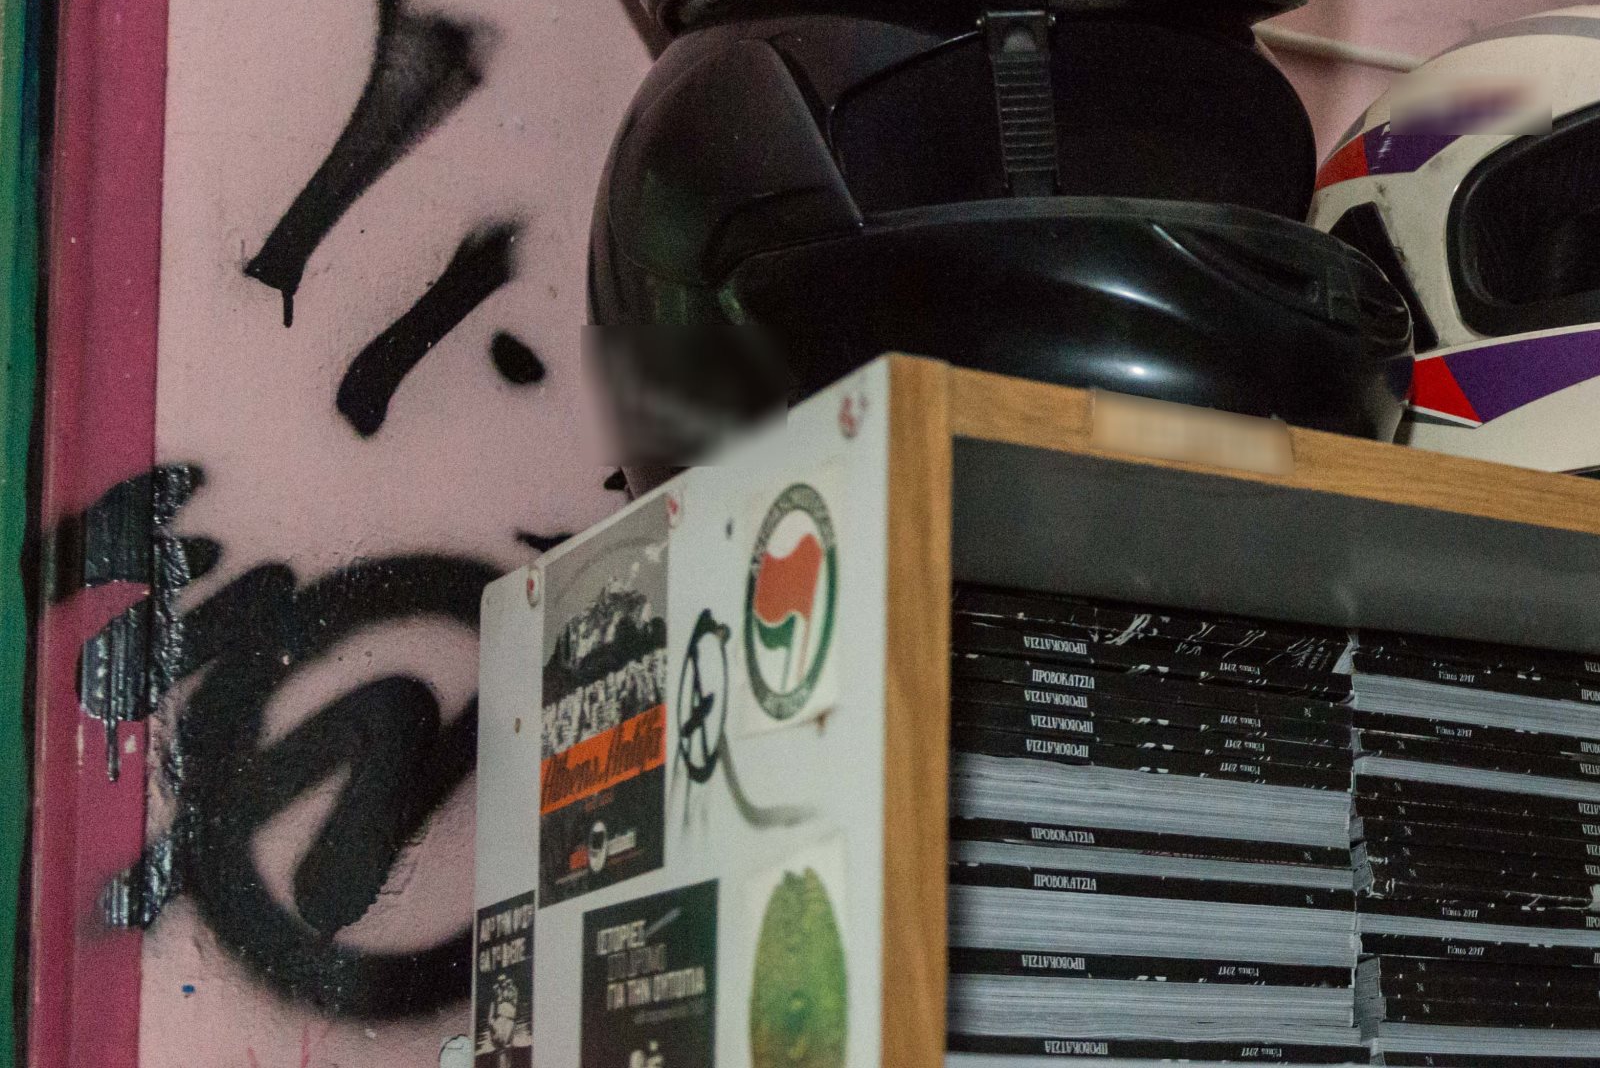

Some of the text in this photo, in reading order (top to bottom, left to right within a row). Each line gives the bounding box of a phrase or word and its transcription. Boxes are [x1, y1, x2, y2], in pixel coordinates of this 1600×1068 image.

[1023, 636, 1088, 655] ΠΡΟΒΟΚΑΤΣΙΑ
[1032, 669, 1095, 689] ΠΡΟΒΟΚΑΤΣΙΑ
[1024, 690, 1088, 708] ΠΡΟΒΟΚΑΤΣΙΑ
[1031, 714, 1094, 733] ΠΡΟΒΟΚΑΤΣΙΑ
[1026, 739, 1089, 758] ΠΡΟΒΟΚΑΤΣΙΑ
[1031, 827, 1095, 845] ΠΡΟΒΟΚΑΤΣΙΑ
[1033, 873, 1097, 891] ΠΡΟΒΟΚΑΤΣΙΑ
[1021, 954, 1085, 970] ΠΡΟΒΟΚΑΤΣΙΑ
[1044, 1040, 1108, 1055] ΠΡΟΒΟΚΑΤΣΙΑ
